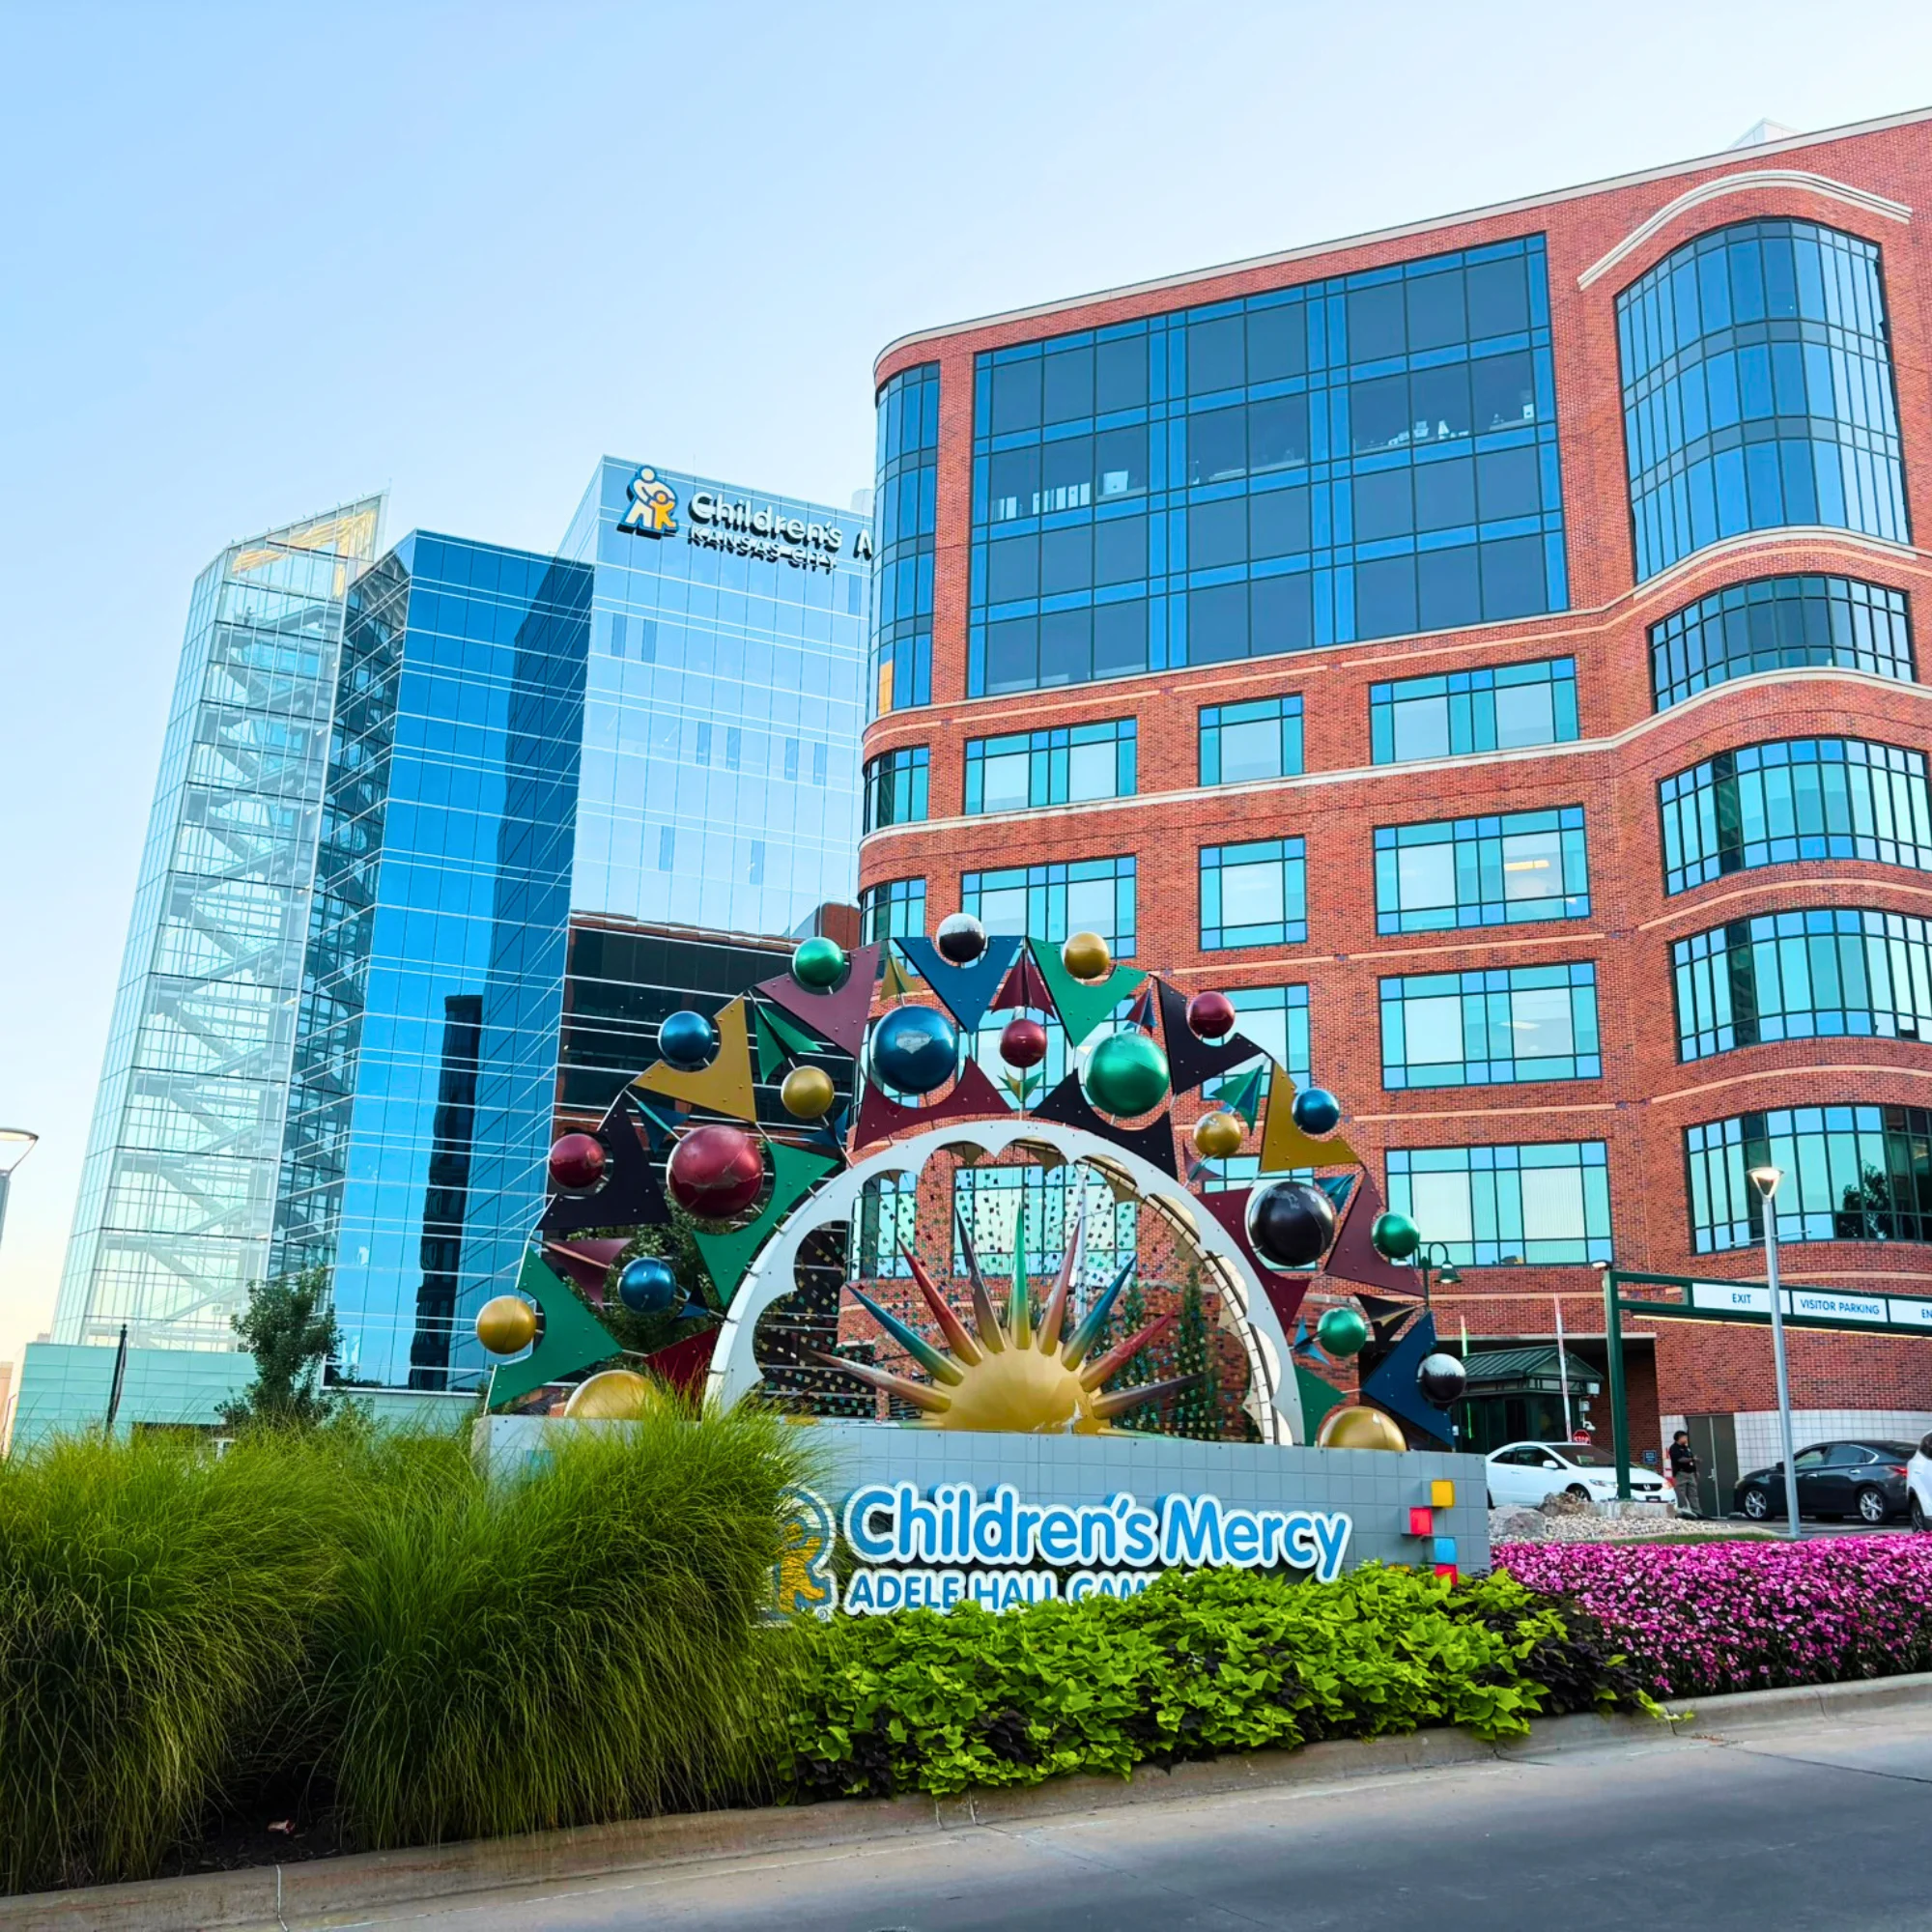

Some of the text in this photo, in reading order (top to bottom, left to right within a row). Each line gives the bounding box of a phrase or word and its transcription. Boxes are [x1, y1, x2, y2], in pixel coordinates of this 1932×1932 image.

[689, 491, 843, 549] Children's
[690, 526, 838, 570] KANSAS CITY
[1732, 1293, 1751, 1304] EXIT
[1800, 1298, 1880, 1315] VISITOR PARKING
[848, 1485, 1347, 1579] Children's Mercy
[848, 1574, 961, 1609] ADELE
